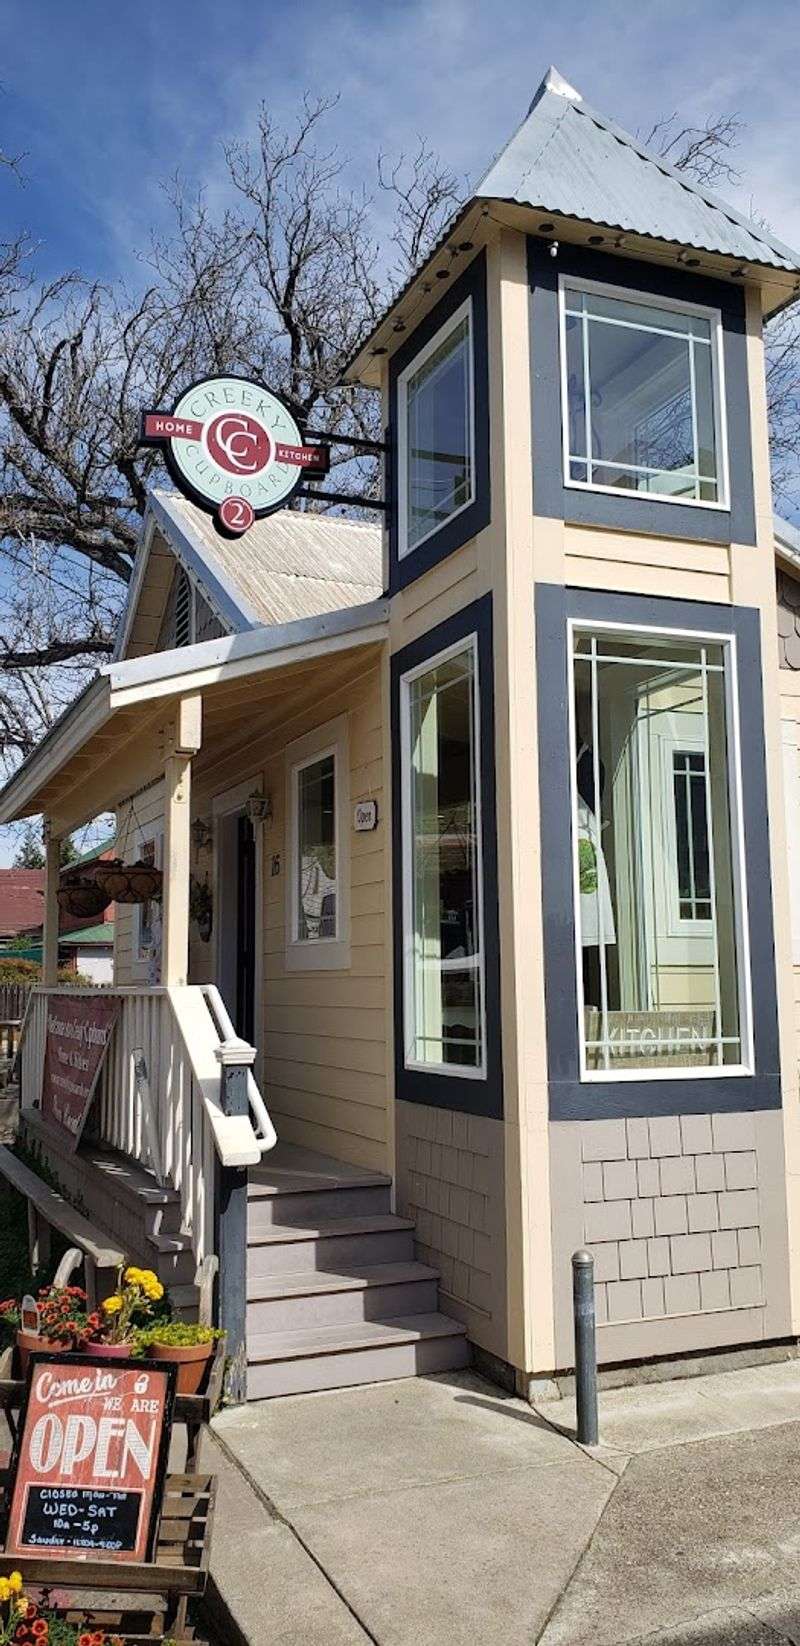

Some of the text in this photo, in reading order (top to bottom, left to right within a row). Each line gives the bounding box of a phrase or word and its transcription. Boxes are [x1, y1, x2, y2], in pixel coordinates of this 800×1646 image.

[191, 387, 286, 430] CREEKY
[156, 421, 193, 435] HOME
[278, 448, 320, 463] KITCHEN
[230, 502, 245, 524] 2
[36, 1369, 117, 1402] Come in
[103, 1396, 160, 1413] WE ARE
[29, 1412, 157, 1480] OPEN
